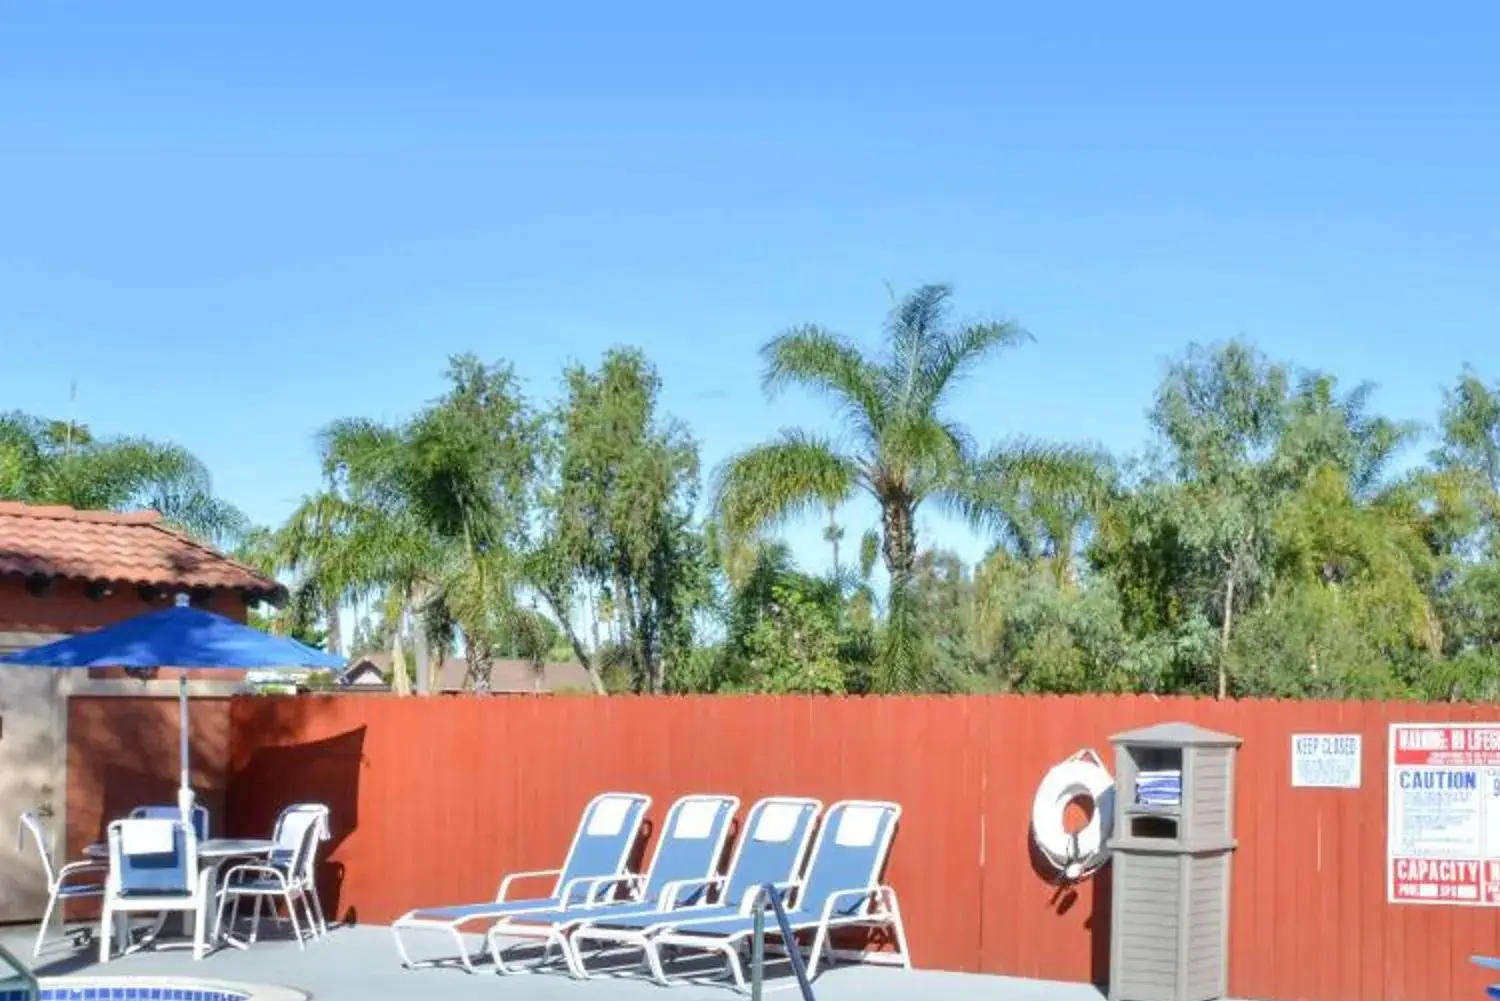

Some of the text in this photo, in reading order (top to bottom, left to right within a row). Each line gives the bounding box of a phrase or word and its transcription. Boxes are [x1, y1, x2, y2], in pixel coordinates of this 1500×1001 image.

[1450, 730, 1465, 751] NO
[1400, 771, 1477, 789] CAUTION
[1397, 860, 1478, 882] CAPACITY
